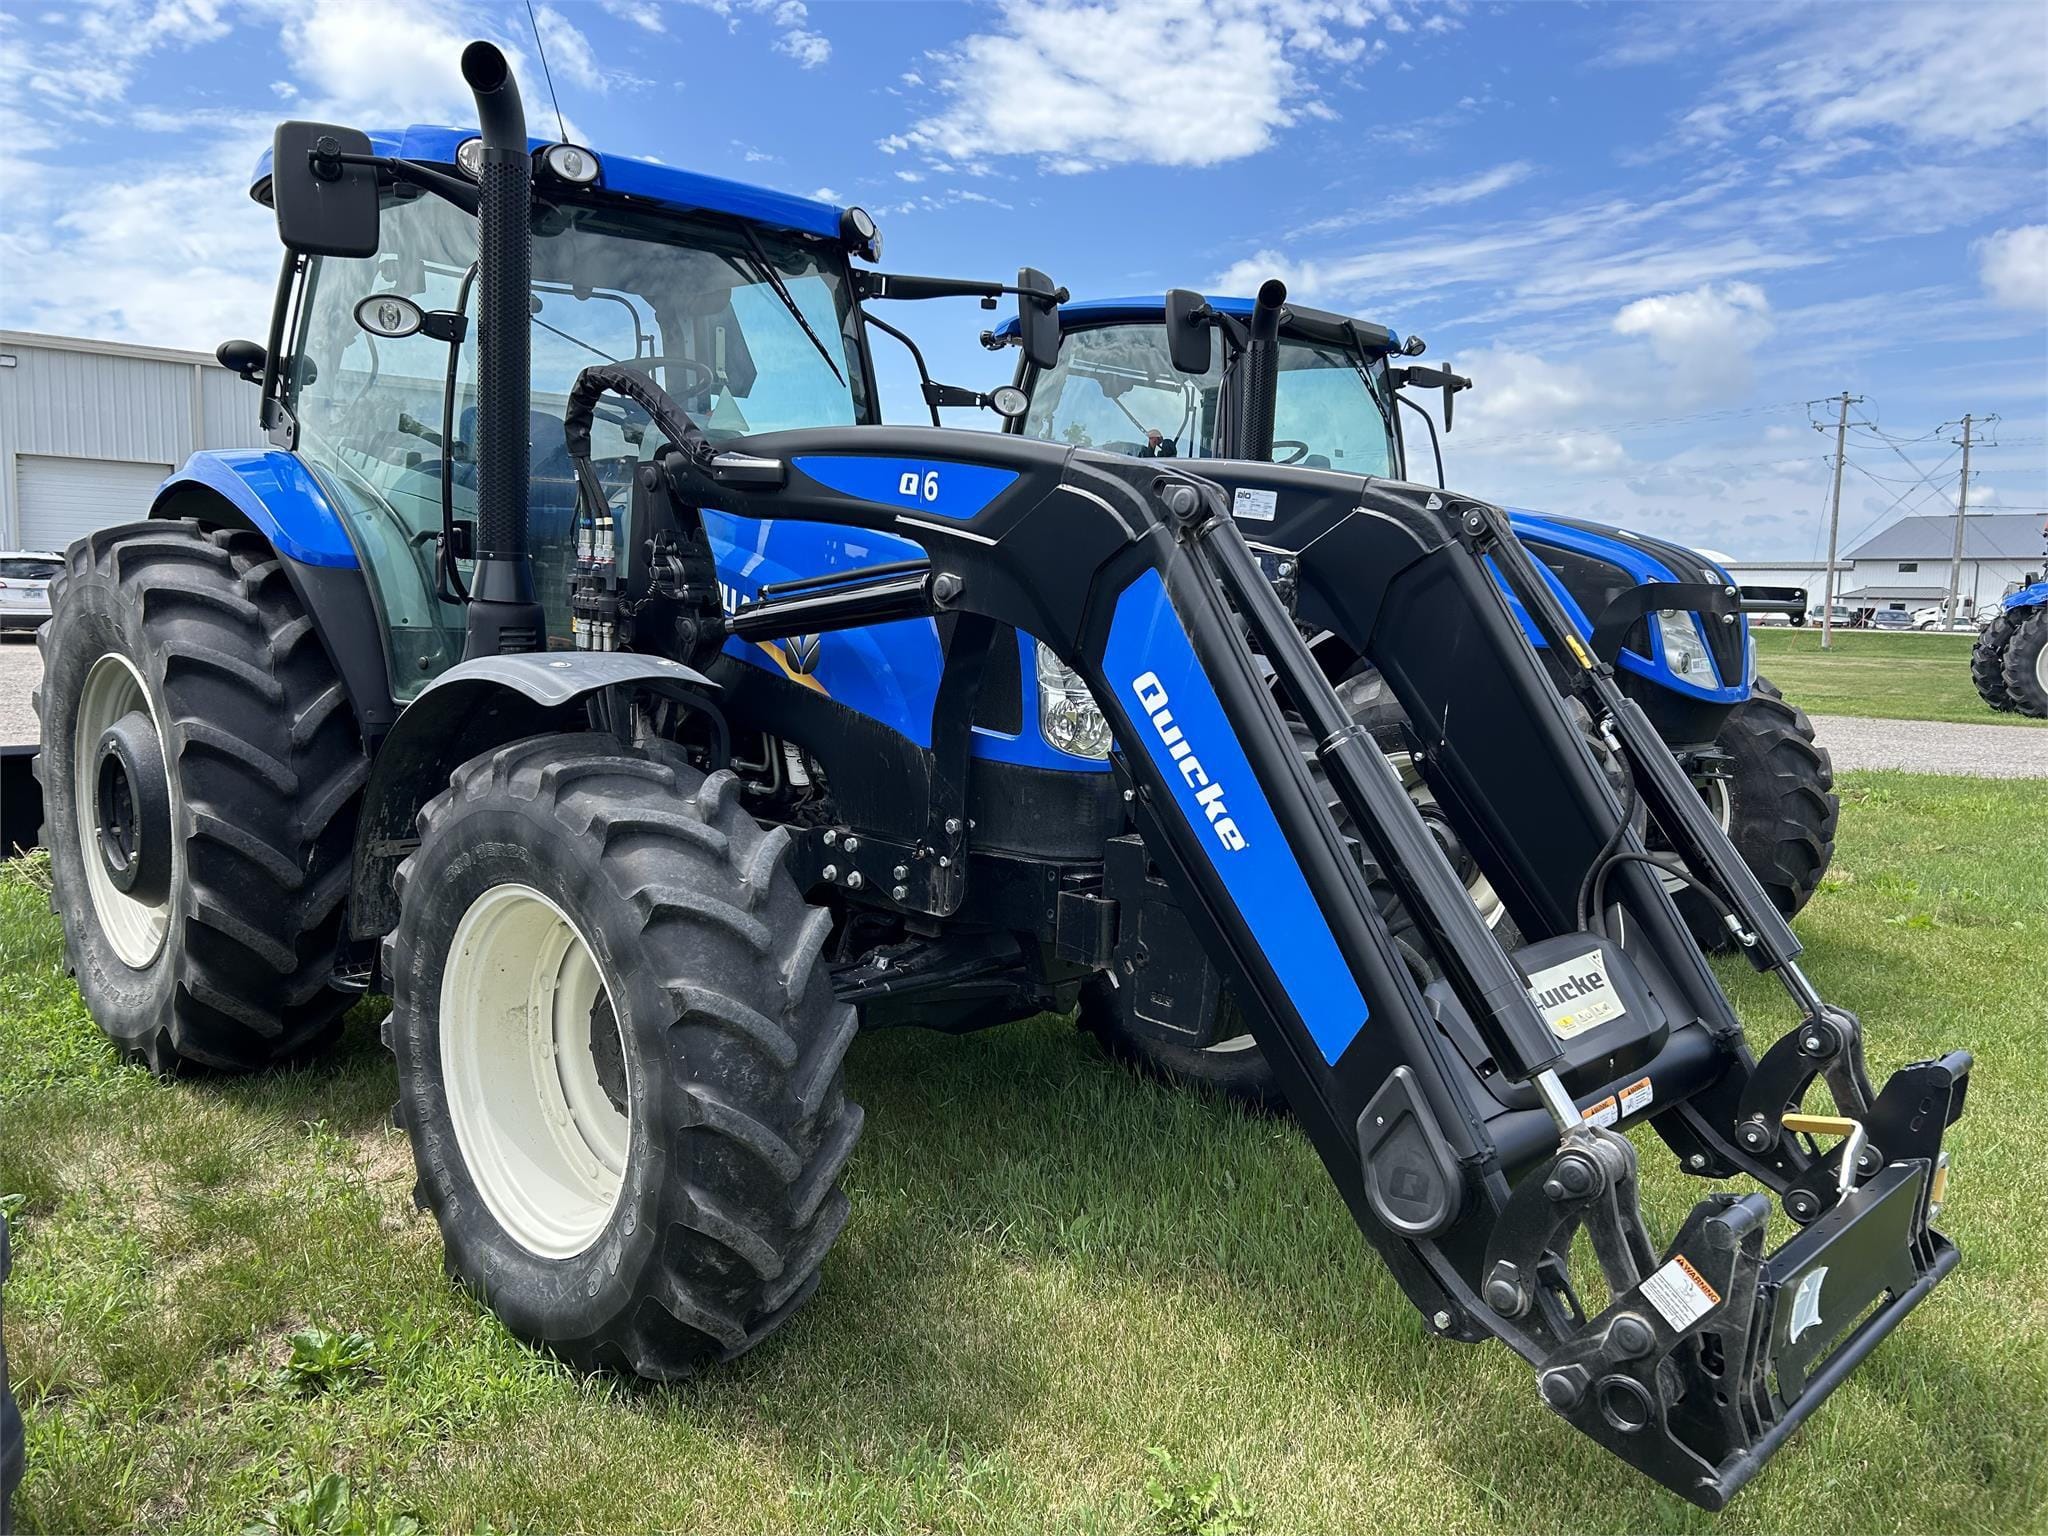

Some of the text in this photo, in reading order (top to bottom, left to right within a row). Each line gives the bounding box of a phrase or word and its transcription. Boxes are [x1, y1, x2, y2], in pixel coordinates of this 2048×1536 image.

[1132, 671, 1246, 851] Quicke
[1538, 972, 1605, 1010] uicke
[1683, 1262, 1719, 1303] WARNING
